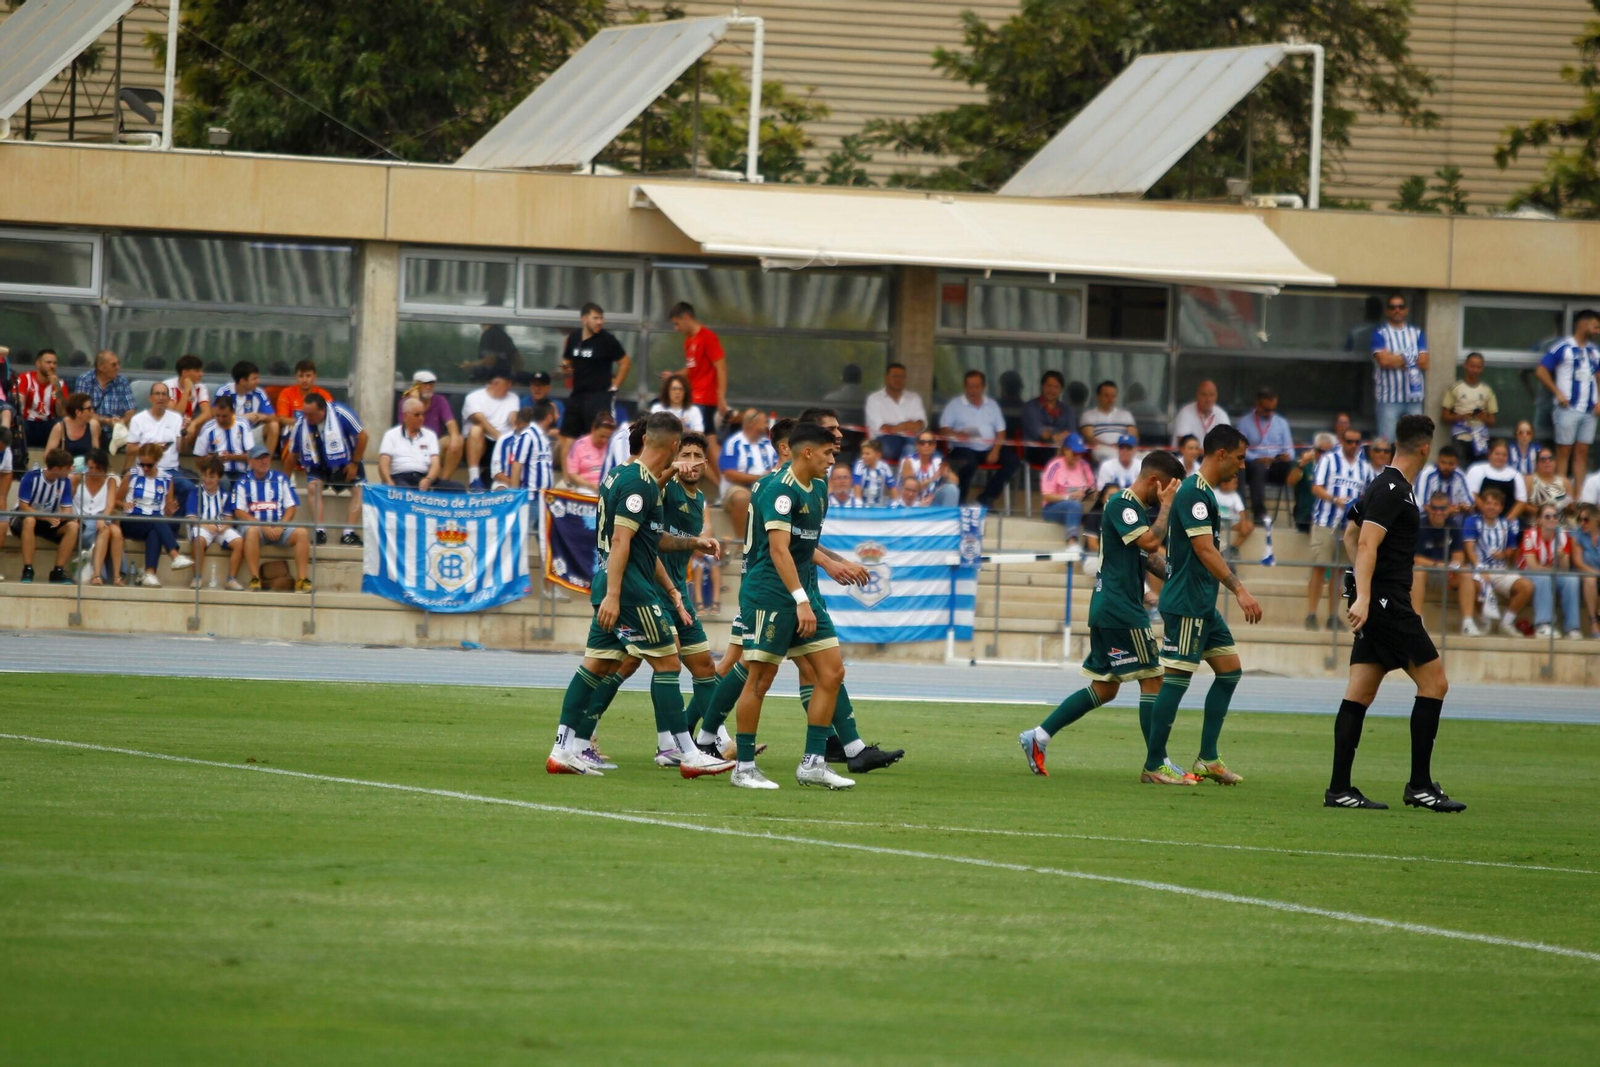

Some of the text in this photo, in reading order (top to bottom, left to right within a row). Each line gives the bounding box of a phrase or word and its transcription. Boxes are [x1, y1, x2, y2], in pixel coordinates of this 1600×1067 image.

[387, 489, 514, 509] Un Decano de Primera
